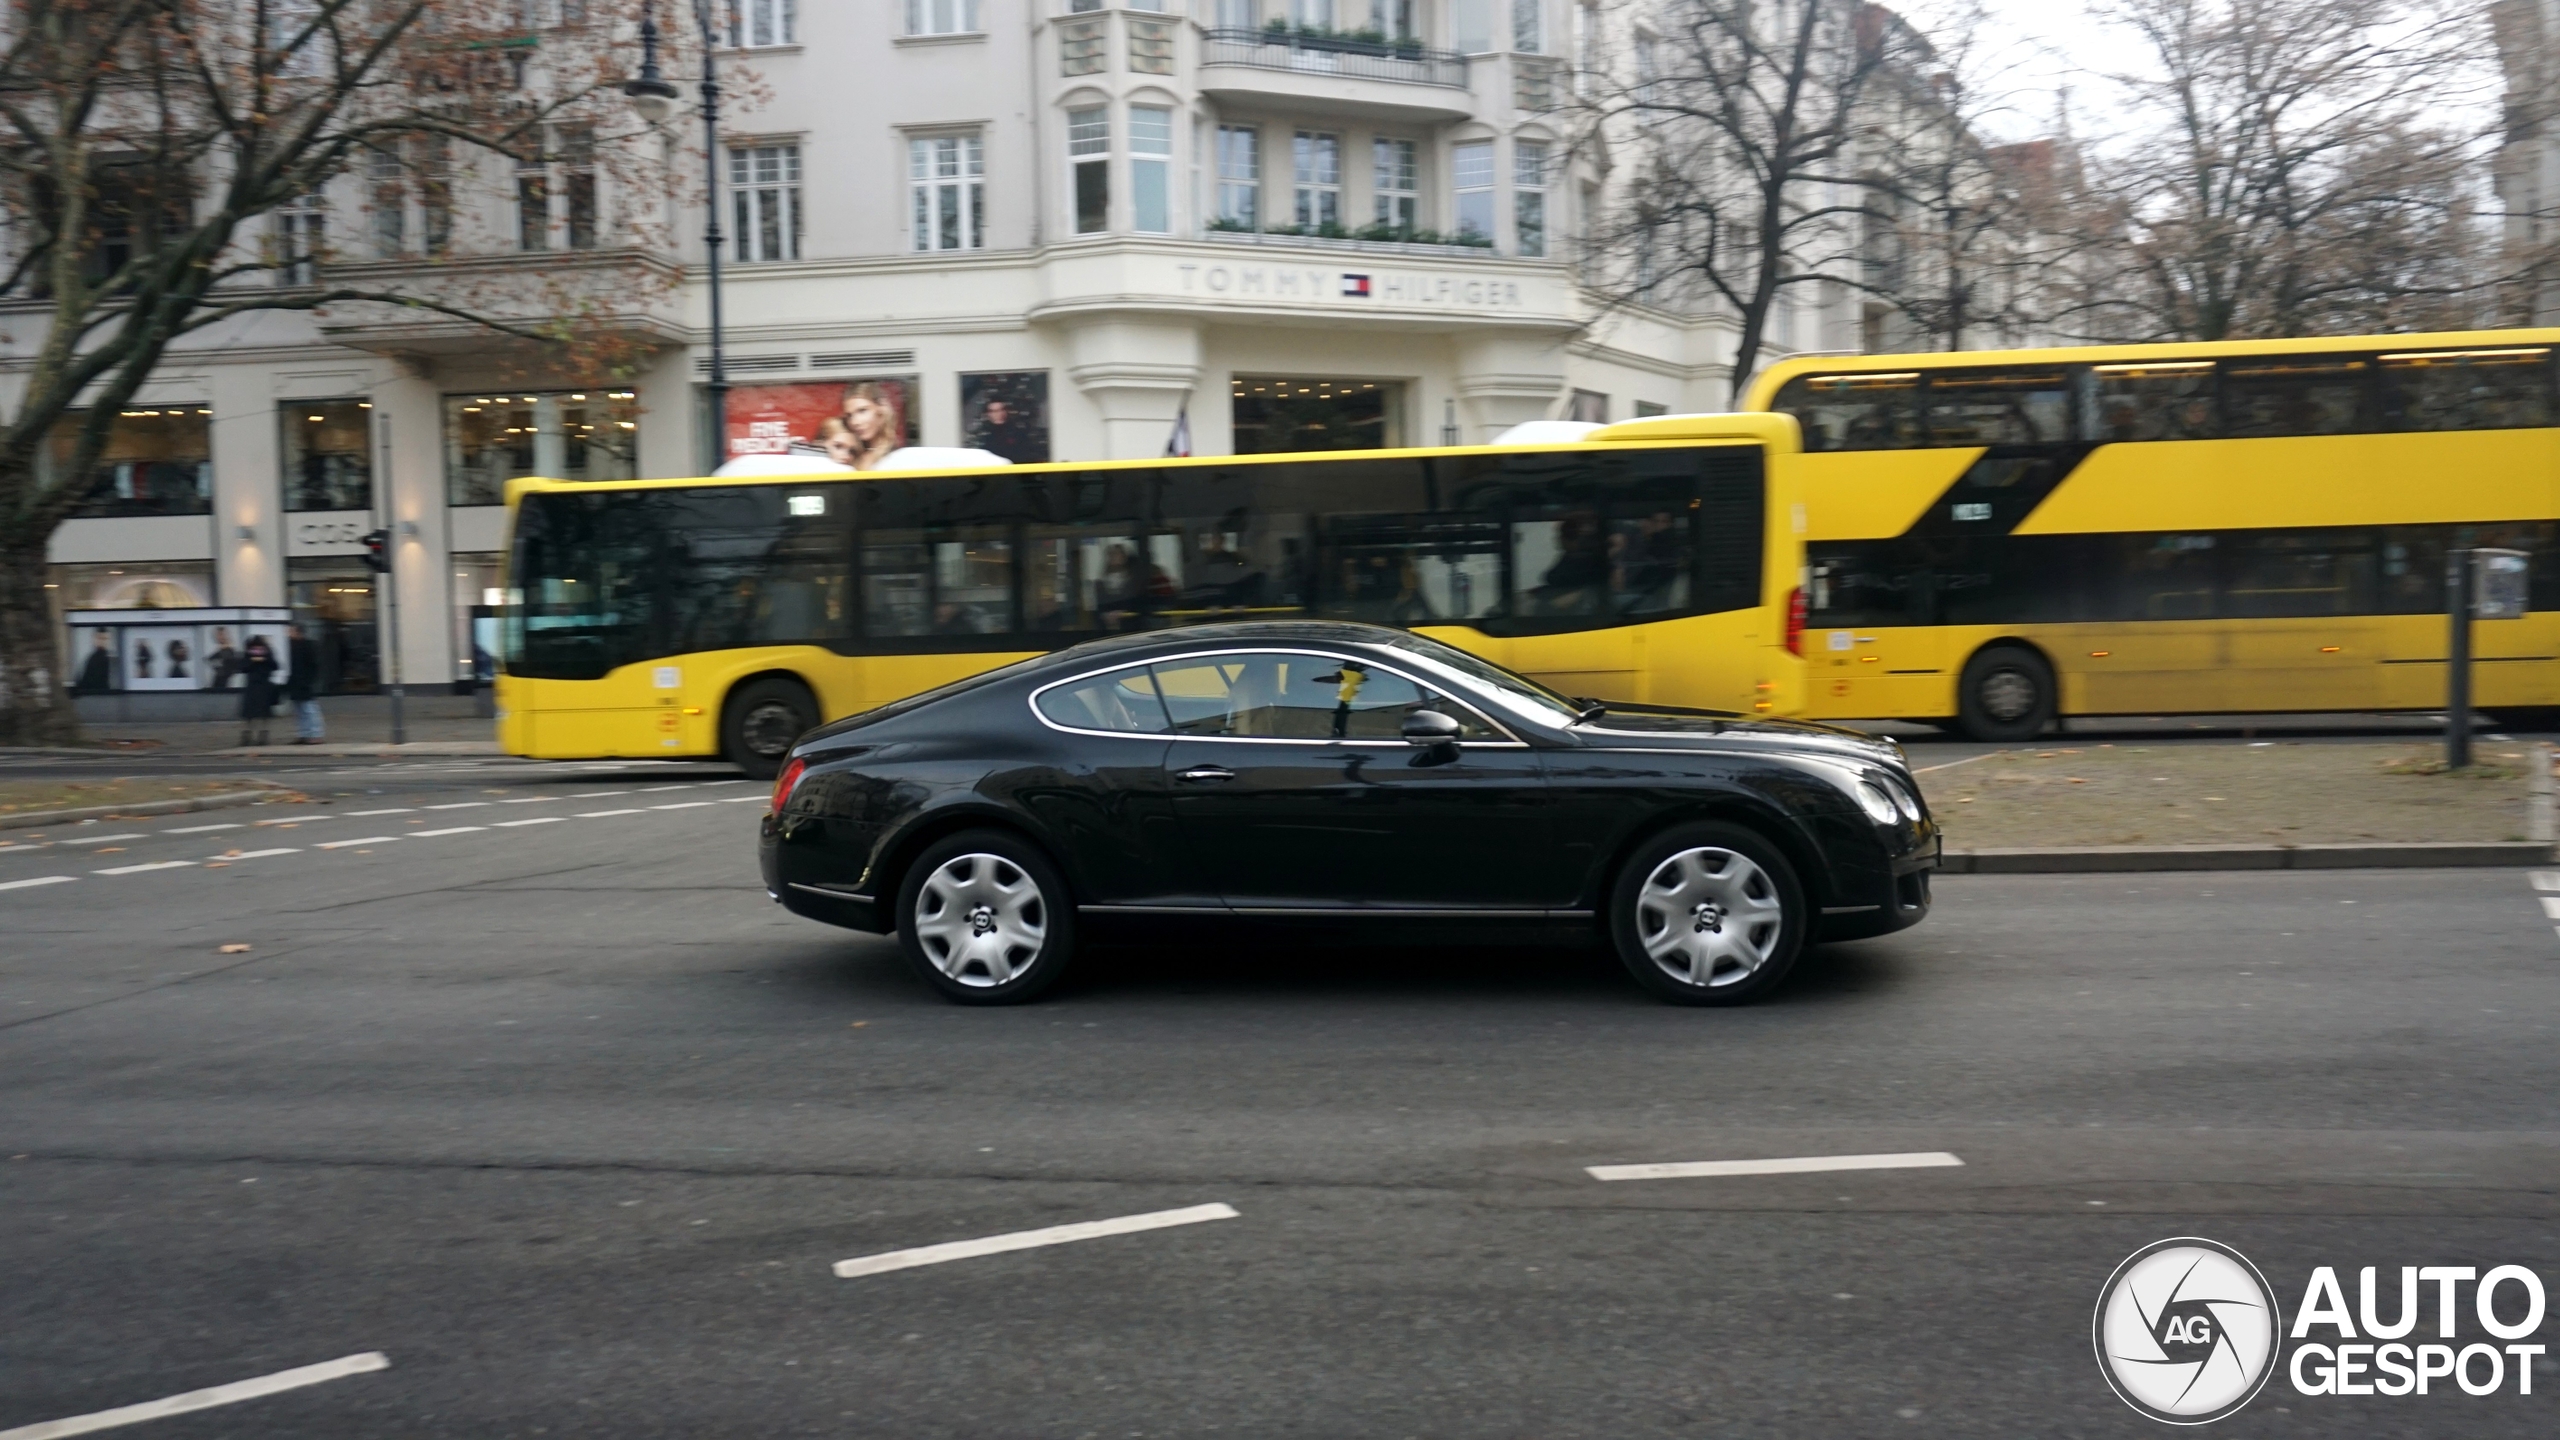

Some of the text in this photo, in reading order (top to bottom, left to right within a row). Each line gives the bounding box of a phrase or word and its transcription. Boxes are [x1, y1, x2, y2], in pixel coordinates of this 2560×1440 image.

[1178, 263, 1523, 306] TOMMY HILFIGER
[299, 523, 359, 545] COS
